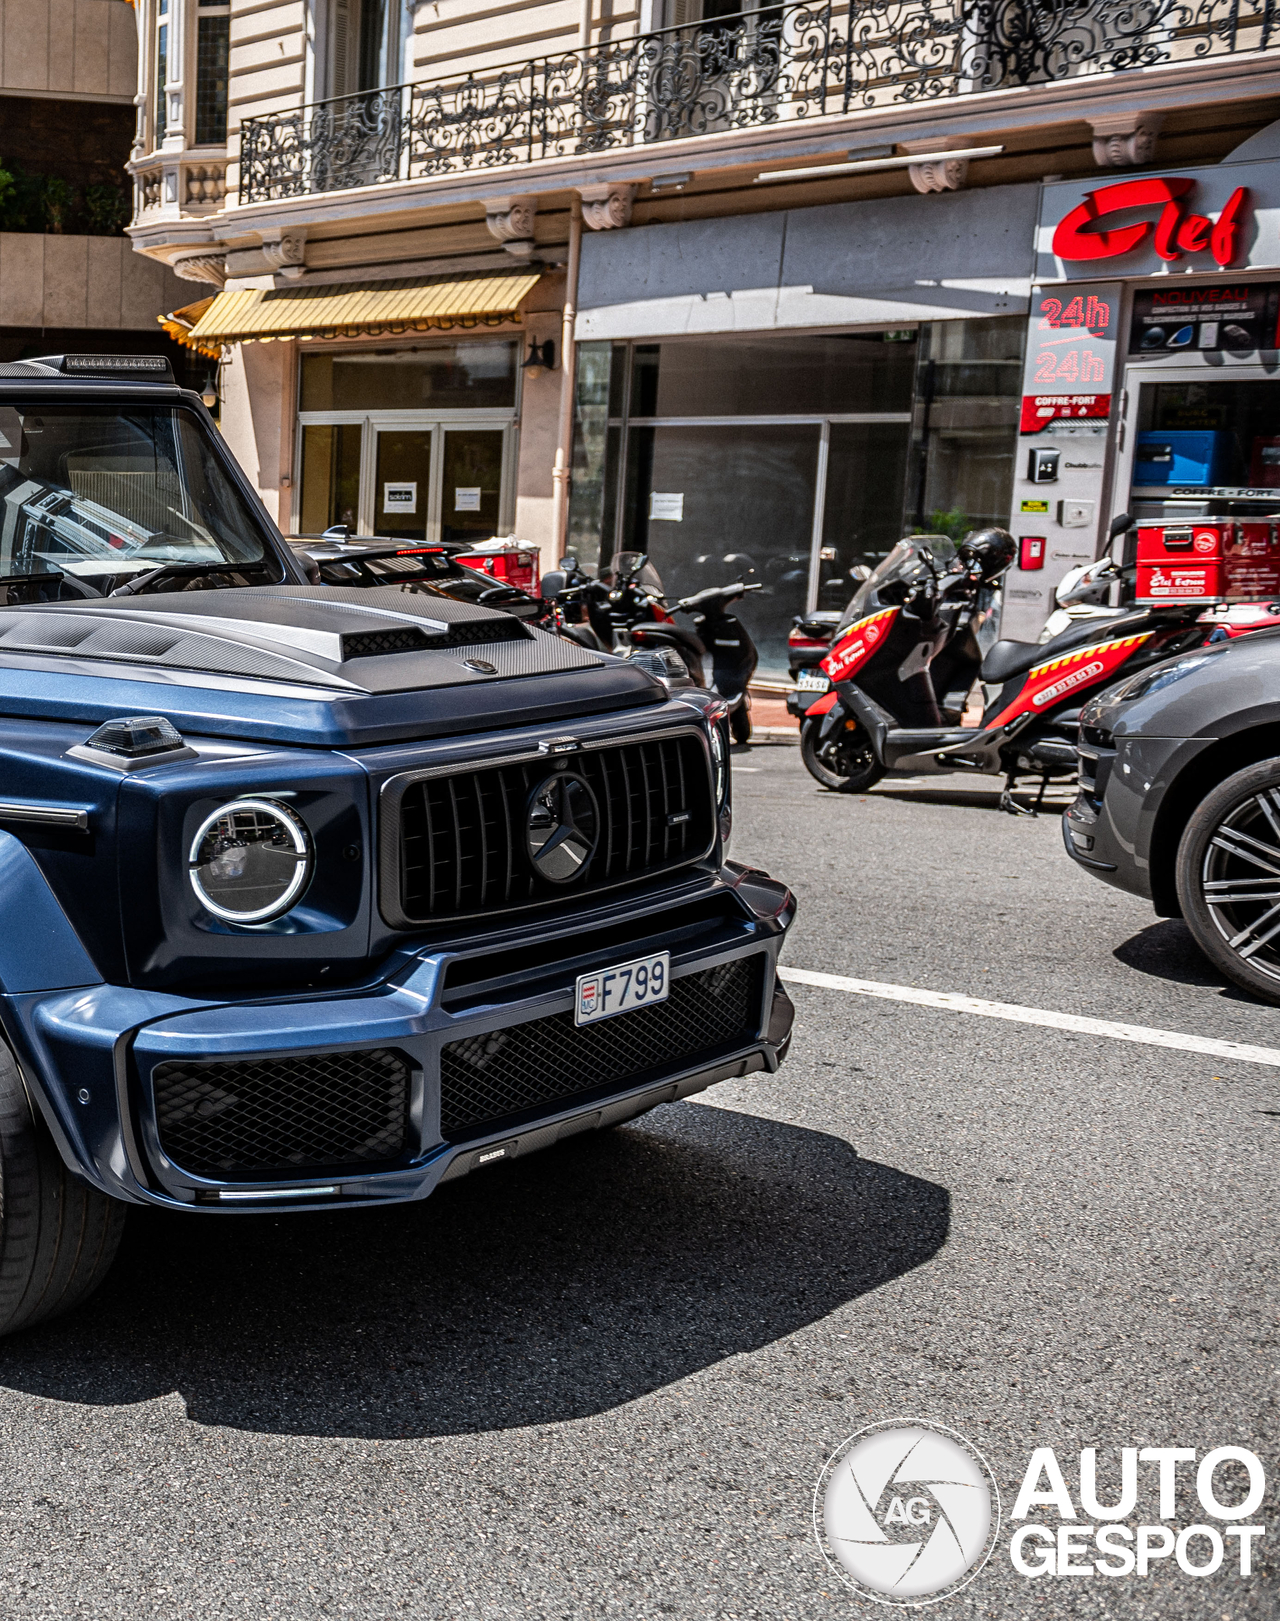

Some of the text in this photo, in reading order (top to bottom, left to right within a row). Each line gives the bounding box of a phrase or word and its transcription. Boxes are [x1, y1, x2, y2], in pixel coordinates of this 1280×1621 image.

[1052, 177, 1249, 266] Clef
[1152, 287, 1249, 305] NOUVEAU
[1037, 295, 1110, 331] 24h
[1033, 349, 1104, 384] 24h
[1034, 395, 1097, 406] COFFRE-FORT
[1172, 487, 1226, 496] COFFRE
[1236, 489, 1274, 497] FORT
[601, 960, 665, 1012] F799
[582, 998, 595, 1010] MC
